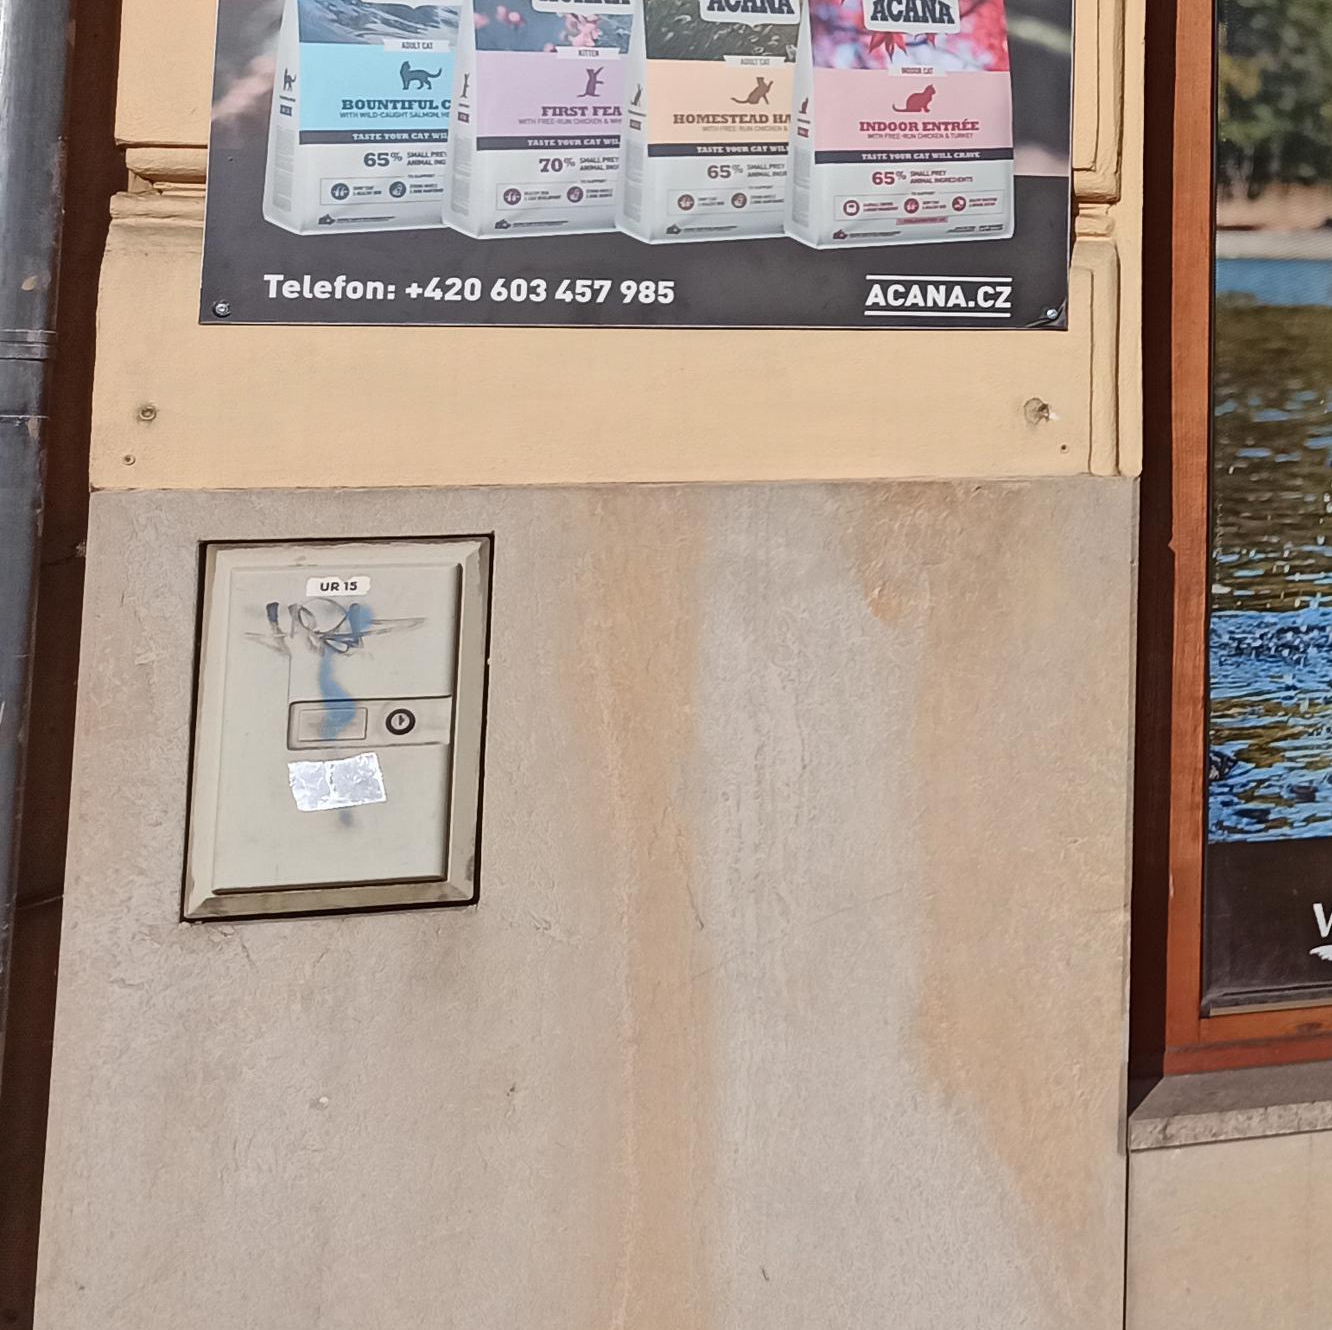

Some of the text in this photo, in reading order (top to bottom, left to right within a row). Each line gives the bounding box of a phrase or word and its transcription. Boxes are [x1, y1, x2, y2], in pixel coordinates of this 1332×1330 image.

[341, 98, 439, 111] BOUNTIFUL
[541, 106, 588, 117] FIRST
[673, 113, 769, 124] HOMESTEAD
[859, 119, 980, 132] INDOOR ENTRÉE
[352, 133, 382, 141] TASTE
[411, 132, 429, 140] CAT
[364, 151, 403, 168] 65%
[539, 158, 576, 173] 70%
[872, 171, 907, 185] 65%
[263, 274, 676, 304] Telefon: +420 603 457 985
[865, 283, 1012, 308] ACANA.CZ
[320, 580, 358, 592] UR 15
